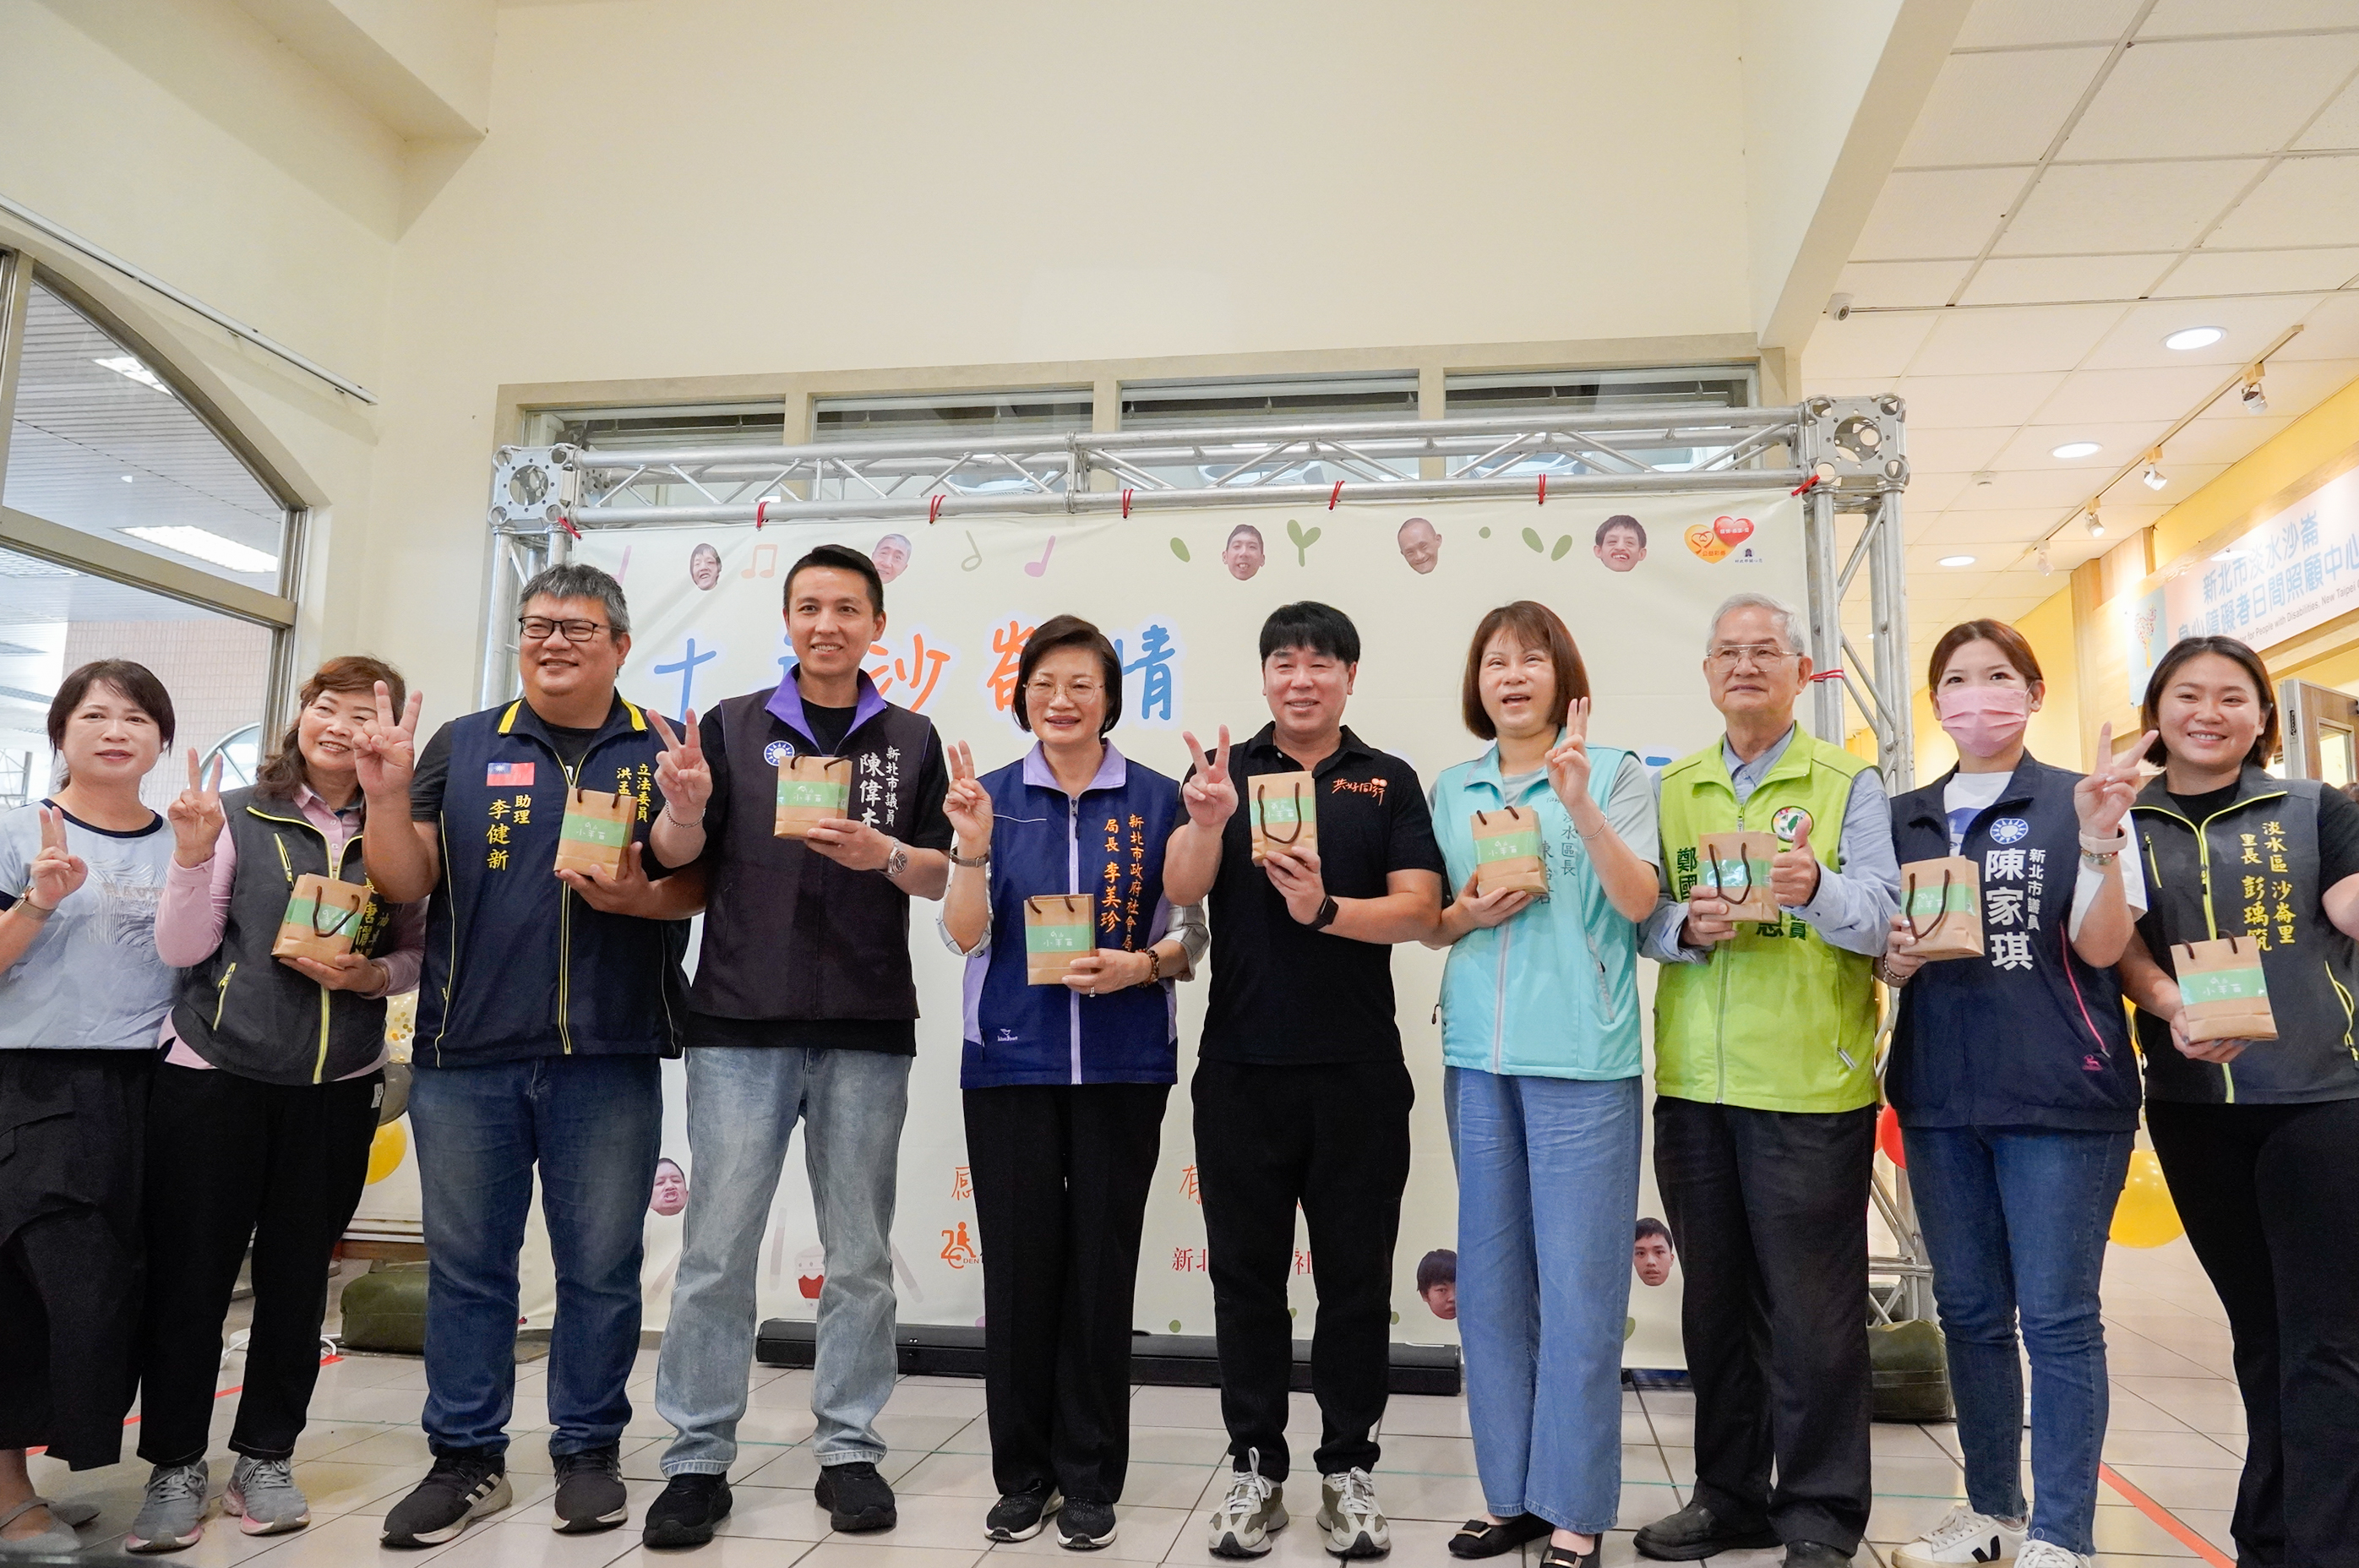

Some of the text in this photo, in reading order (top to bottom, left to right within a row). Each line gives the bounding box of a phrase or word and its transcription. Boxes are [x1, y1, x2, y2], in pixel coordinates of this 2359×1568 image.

[2255, 622, 2274, 637] People
[2275, 615, 2286, 629] with
[2321, 591, 2335, 606] New
[2335, 580, 2356, 599] Taipei
[513, 793, 532, 825] 助理
[636, 763, 652, 823] 立法委員
[884, 745, 902, 828] 新北市議員
[486, 798, 512, 871] 李健新
[2240, 833, 2263, 864] 里長
[1100, 819, 1122, 934] 局長 李美珍
[1122, 813, 1145, 951] 新北市政府社會局
[1985, 847, 2034, 971] 陳家琪
[2027, 847, 2046, 932] 新北市議員
[2262, 820, 2296, 945] 淡水區 沙崙里
